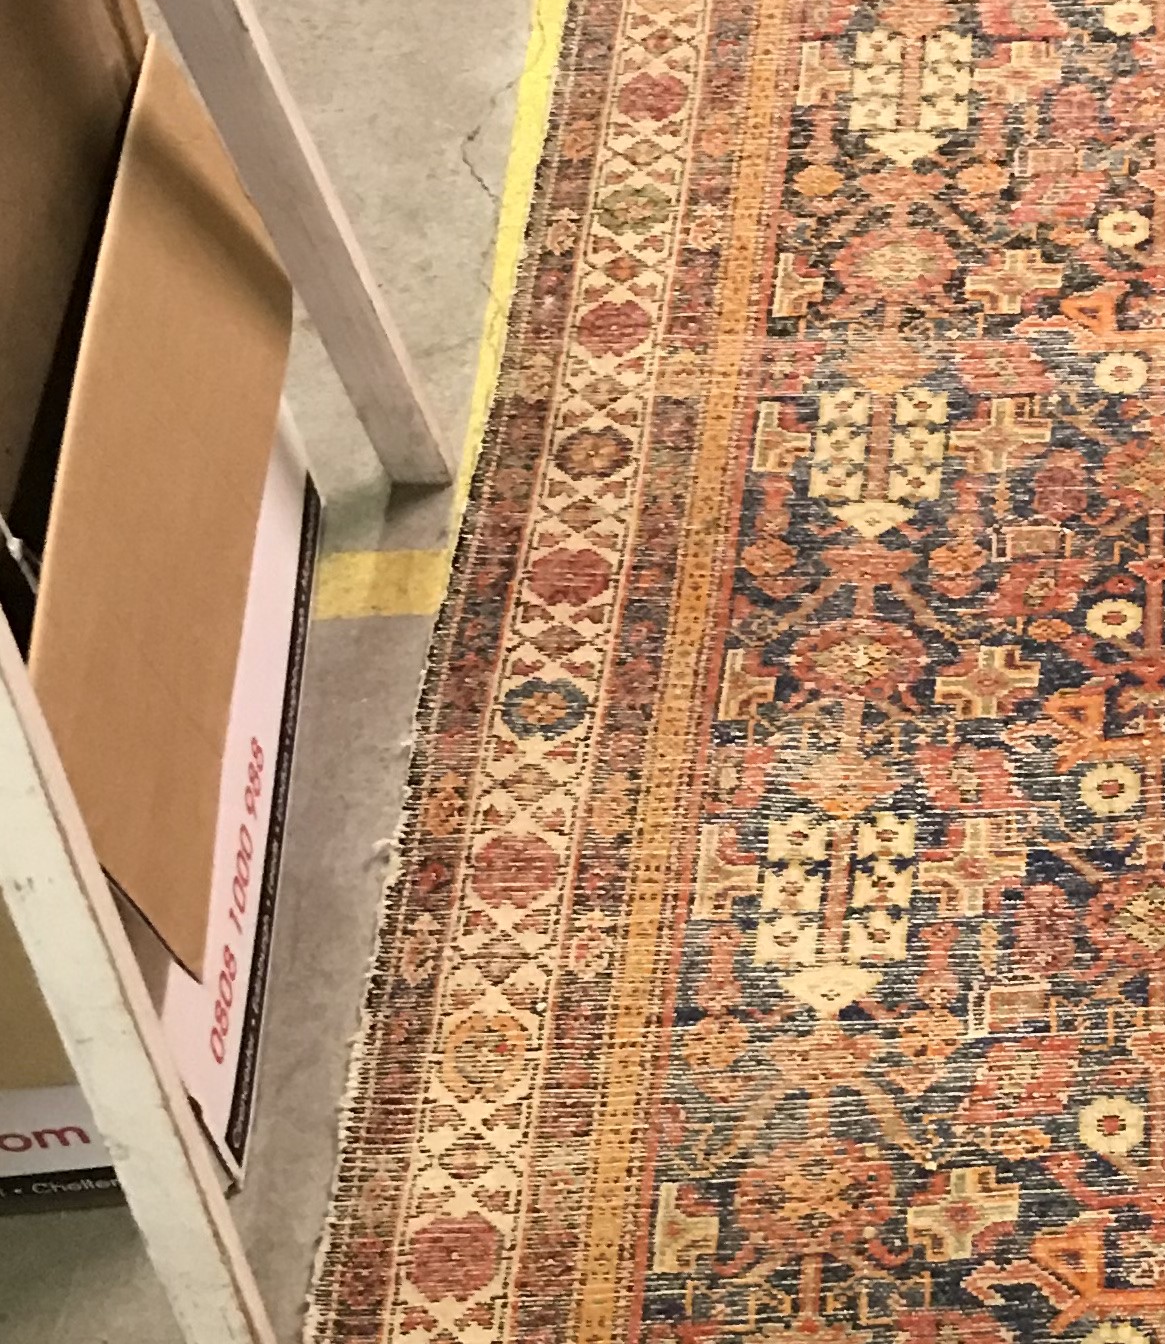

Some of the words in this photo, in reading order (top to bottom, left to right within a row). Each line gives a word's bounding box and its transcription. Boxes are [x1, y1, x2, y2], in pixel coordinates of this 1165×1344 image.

[210, 945, 237, 1065] 0808
[229, 823, 253, 936] 1000
[244, 736, 264, 821] 988
